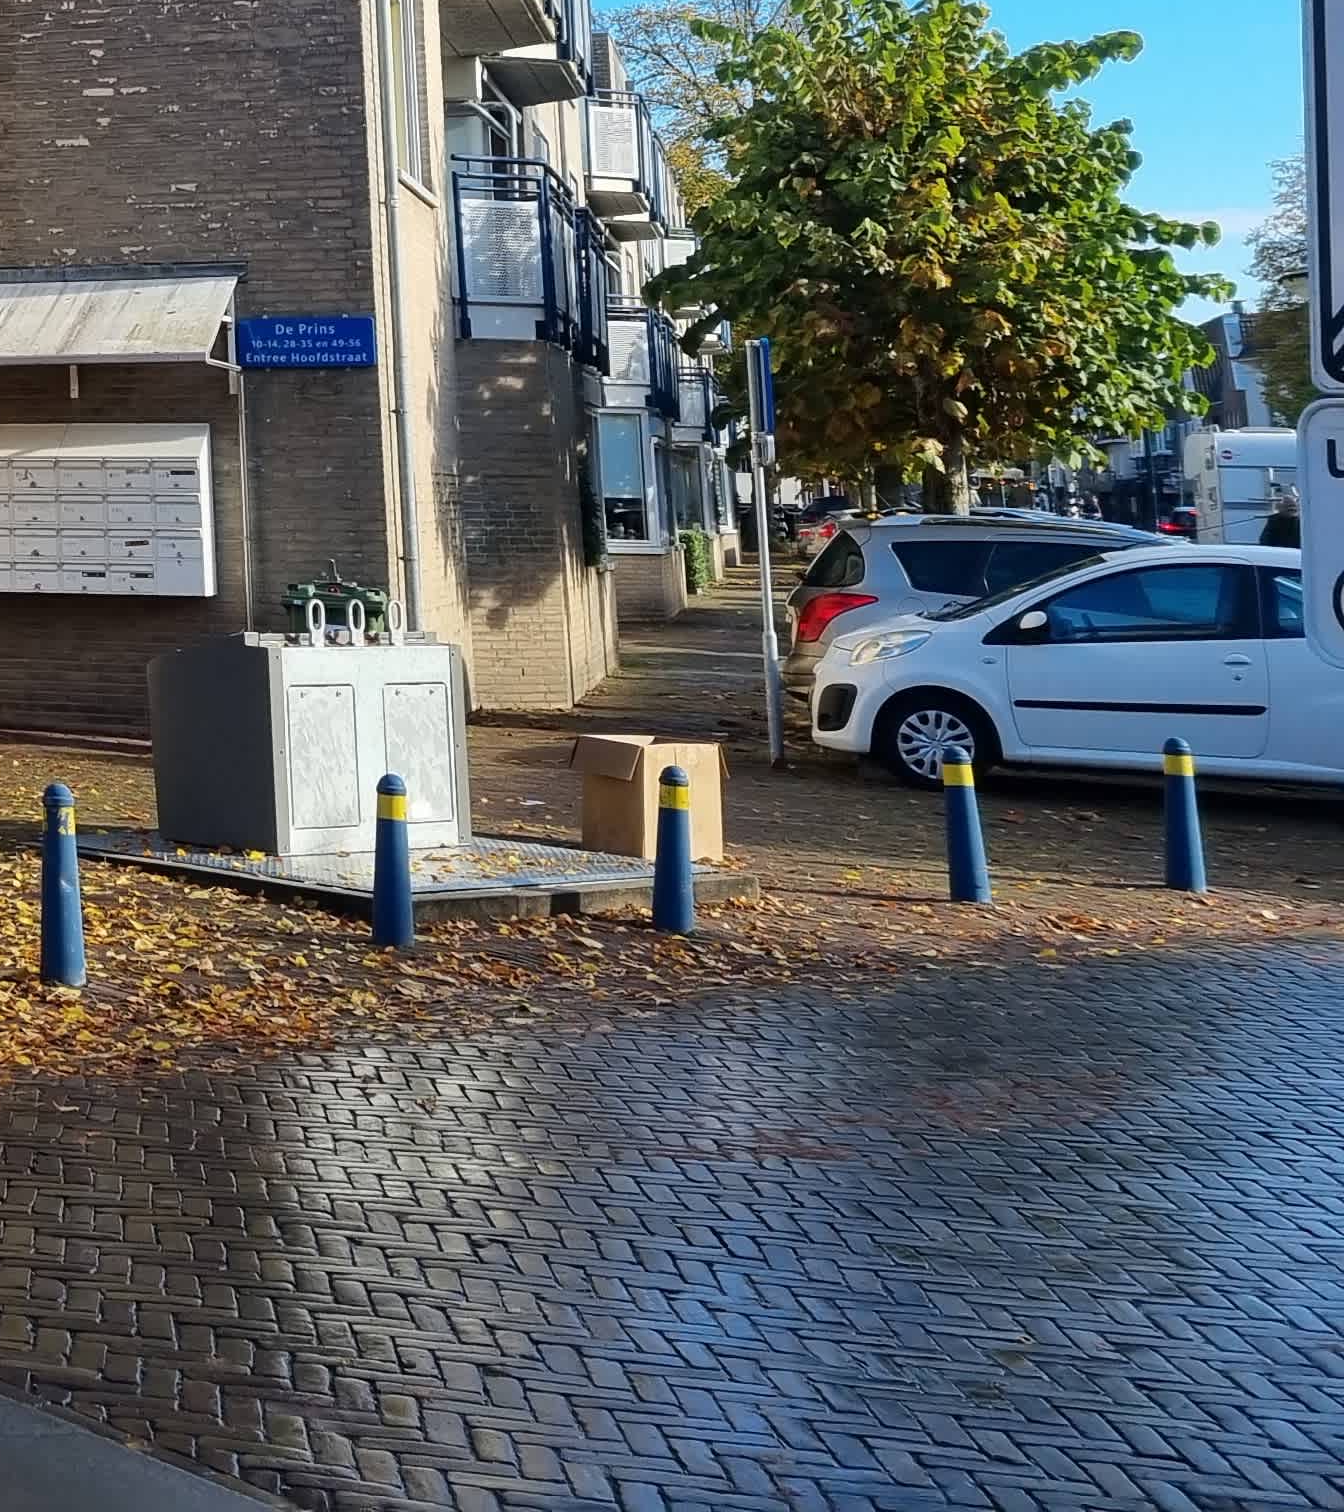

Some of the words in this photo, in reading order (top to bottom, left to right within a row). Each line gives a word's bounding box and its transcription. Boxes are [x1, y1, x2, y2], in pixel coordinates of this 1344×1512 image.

[275, 324, 294, 335] De
[298, 323, 336, 335] Prins
[283, 339, 313, 348] 28-35
[315, 340, 328, 348] en
[331, 338, 361, 348] 49-56
[246, 352, 287, 363] Entree
[291, 352, 368, 363] Hoofdstraat
